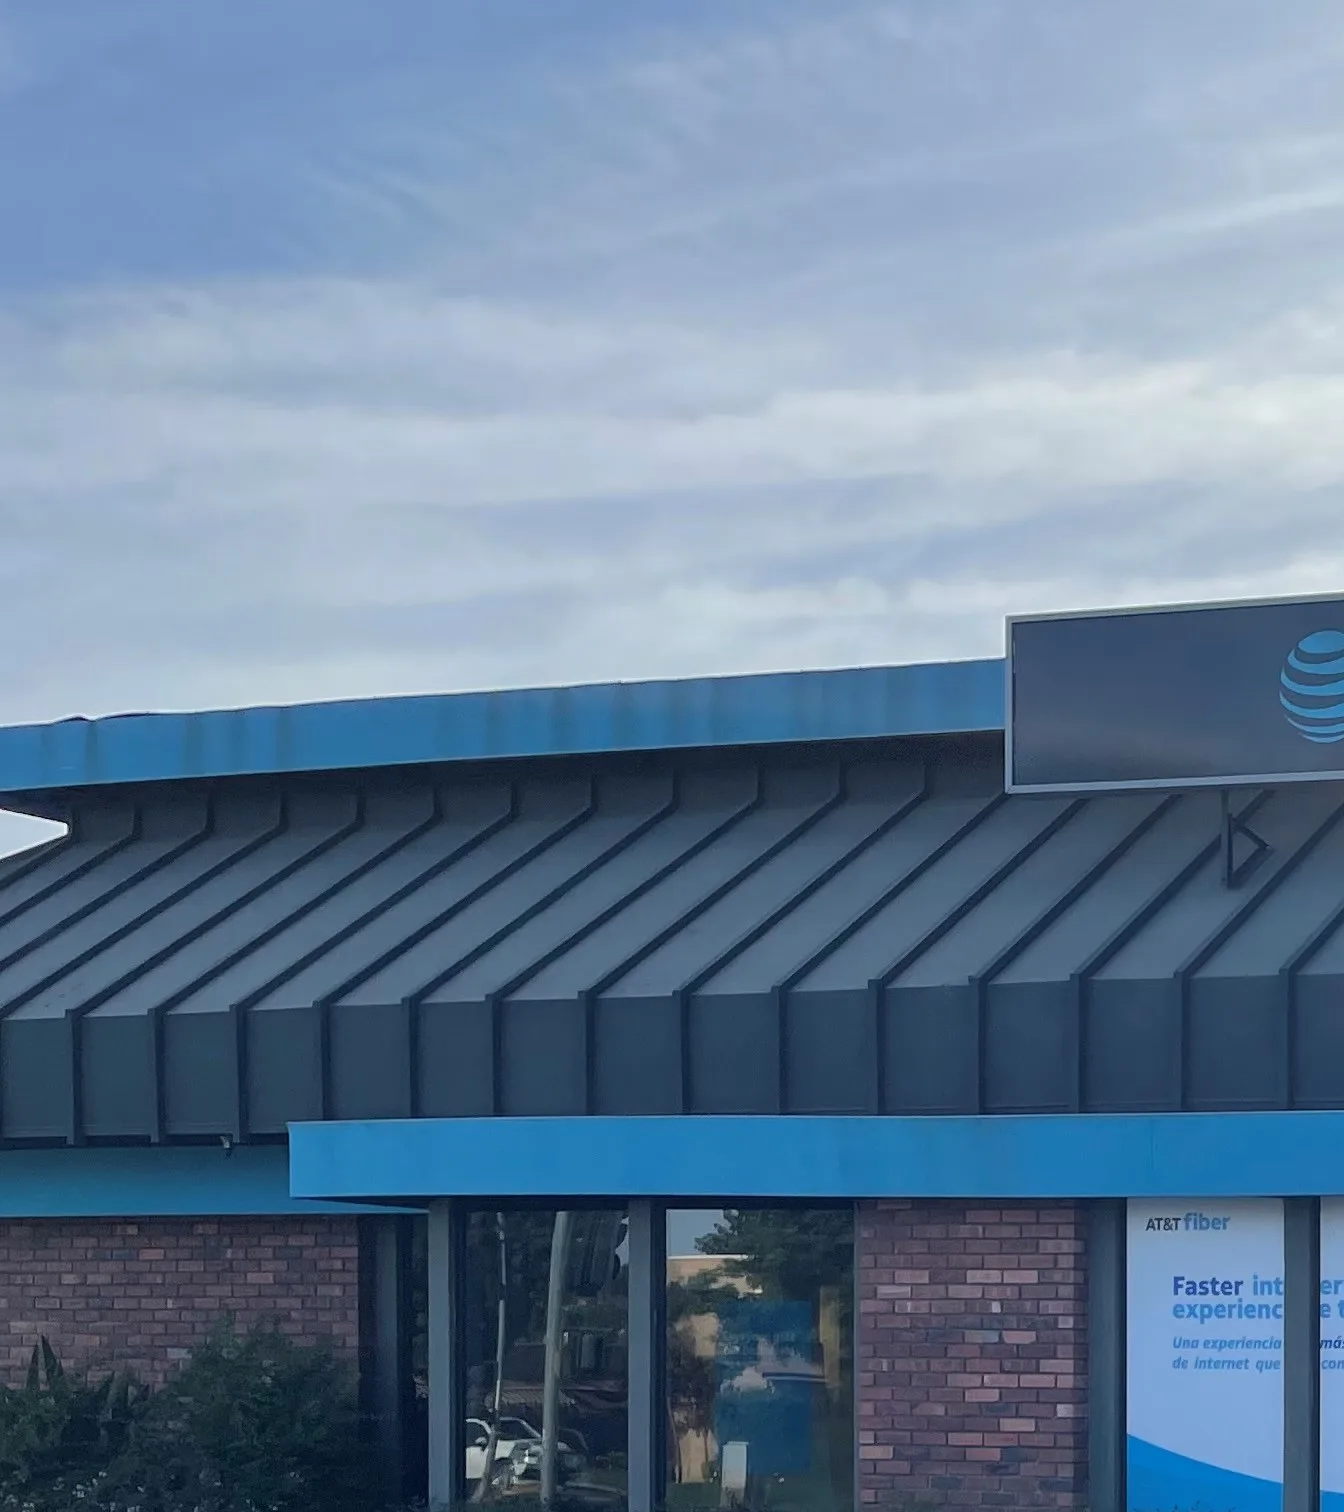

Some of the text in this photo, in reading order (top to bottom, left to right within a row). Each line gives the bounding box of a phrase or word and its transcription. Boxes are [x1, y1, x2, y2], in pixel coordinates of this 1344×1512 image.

[1145, 1212, 1231, 1231] AT&T fiber
[1173, 1276, 1244, 1296] Faster
[1172, 1336, 1199, 1349] Una
[1202, 1335, 1283, 1353] experiencia
[1172, 1355, 1188, 1370] de
[1255, 1358, 1281, 1374] que
[1321, 1358, 1344, 1371] con
